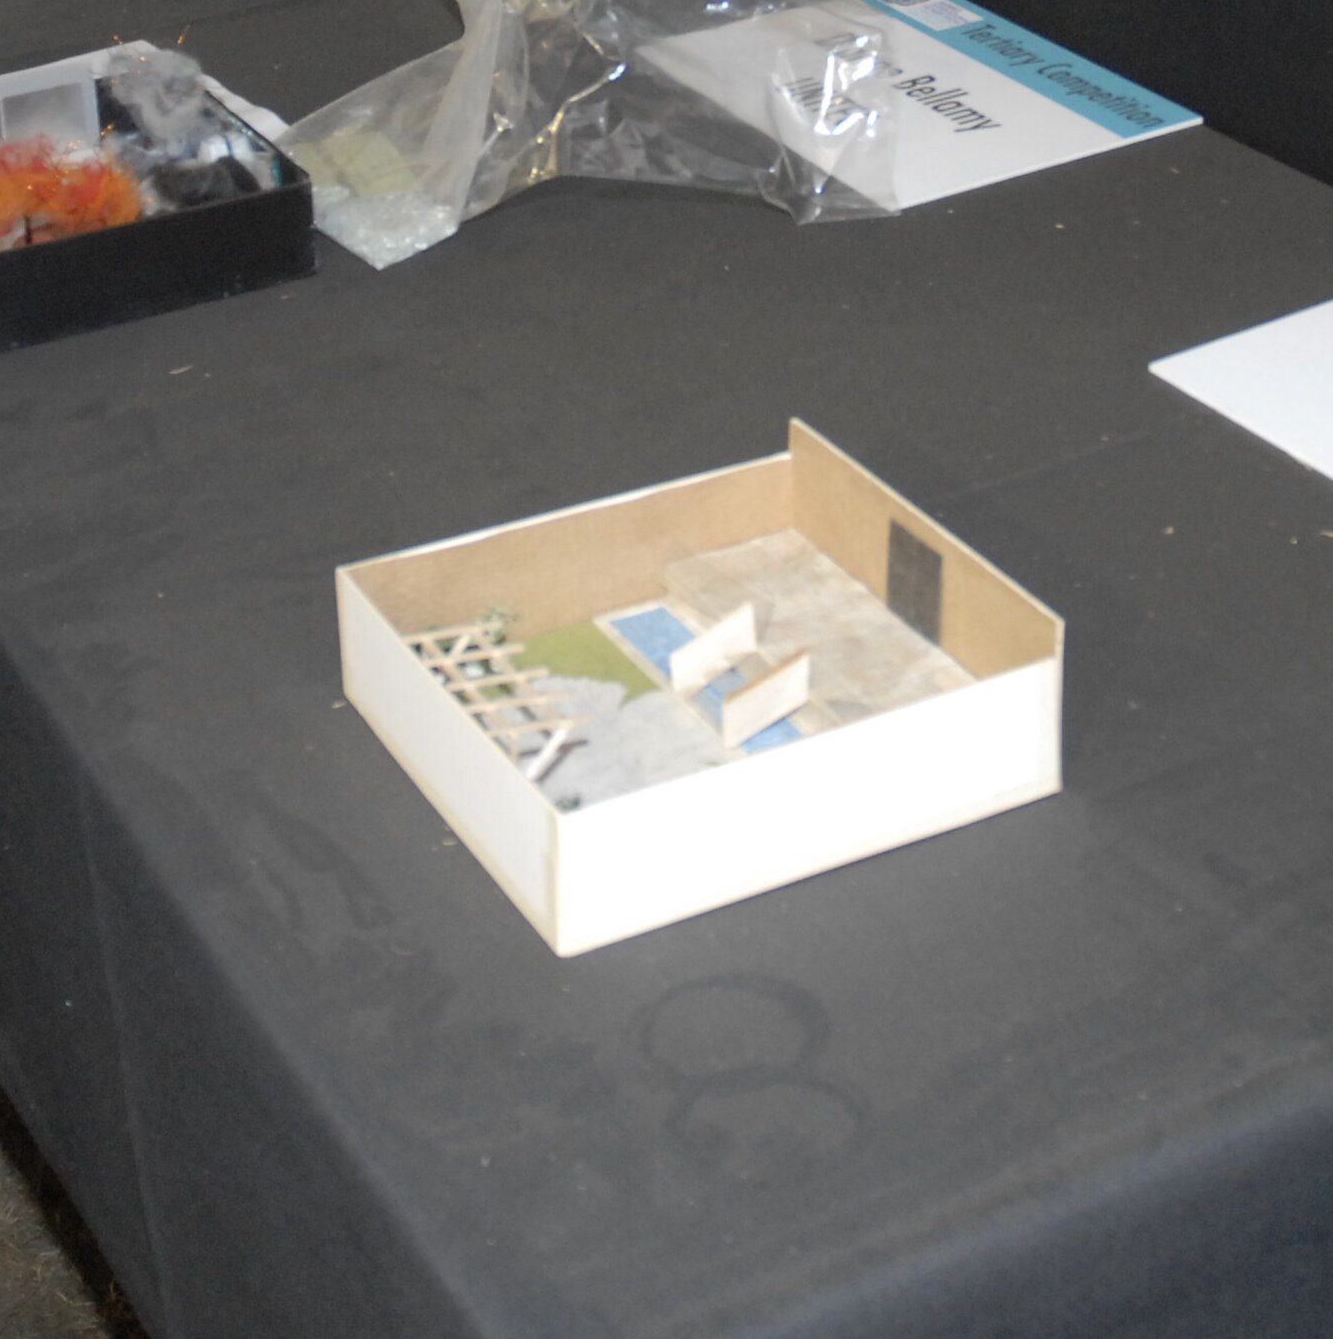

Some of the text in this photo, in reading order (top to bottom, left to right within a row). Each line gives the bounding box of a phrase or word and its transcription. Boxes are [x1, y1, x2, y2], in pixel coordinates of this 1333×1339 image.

[893, 75, 1002, 133] Bellamy
[962, 23, 1046, 68] Tertiary
[1036, 64, 1166, 129] Competition
